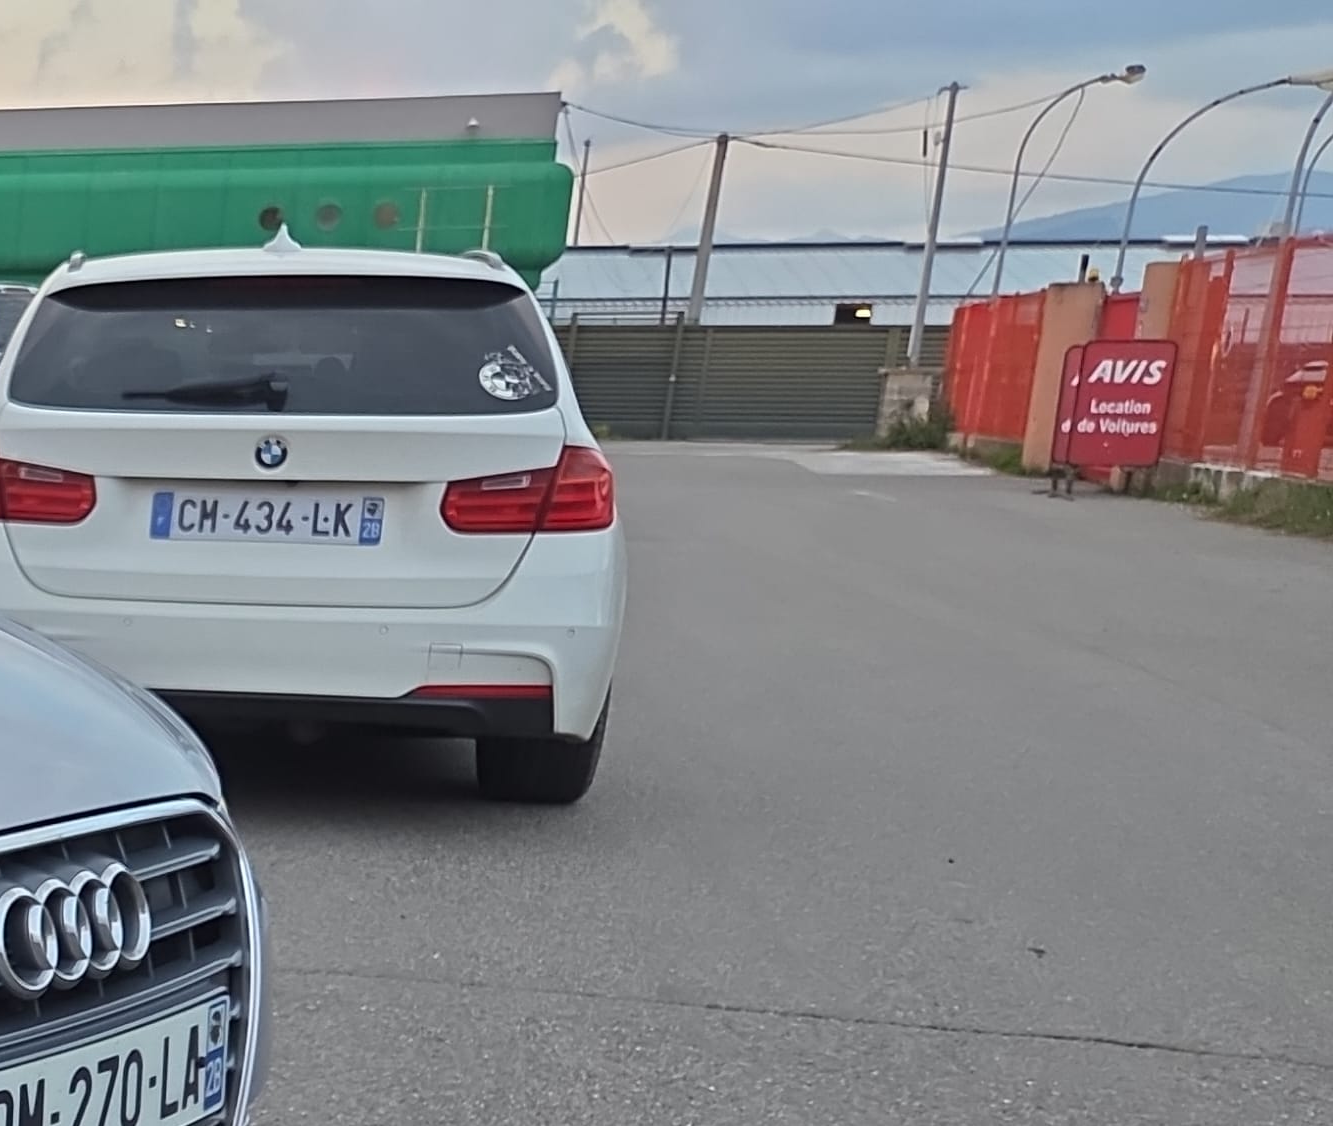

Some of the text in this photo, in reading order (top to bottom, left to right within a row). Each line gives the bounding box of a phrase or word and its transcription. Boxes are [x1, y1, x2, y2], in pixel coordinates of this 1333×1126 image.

[1087, 359, 1167, 385] AVIS
[1090, 399, 1151, 415] Location
[1077, 418, 1157, 436] de Voitures
[178, 499, 354, 538] CM-434-LK
